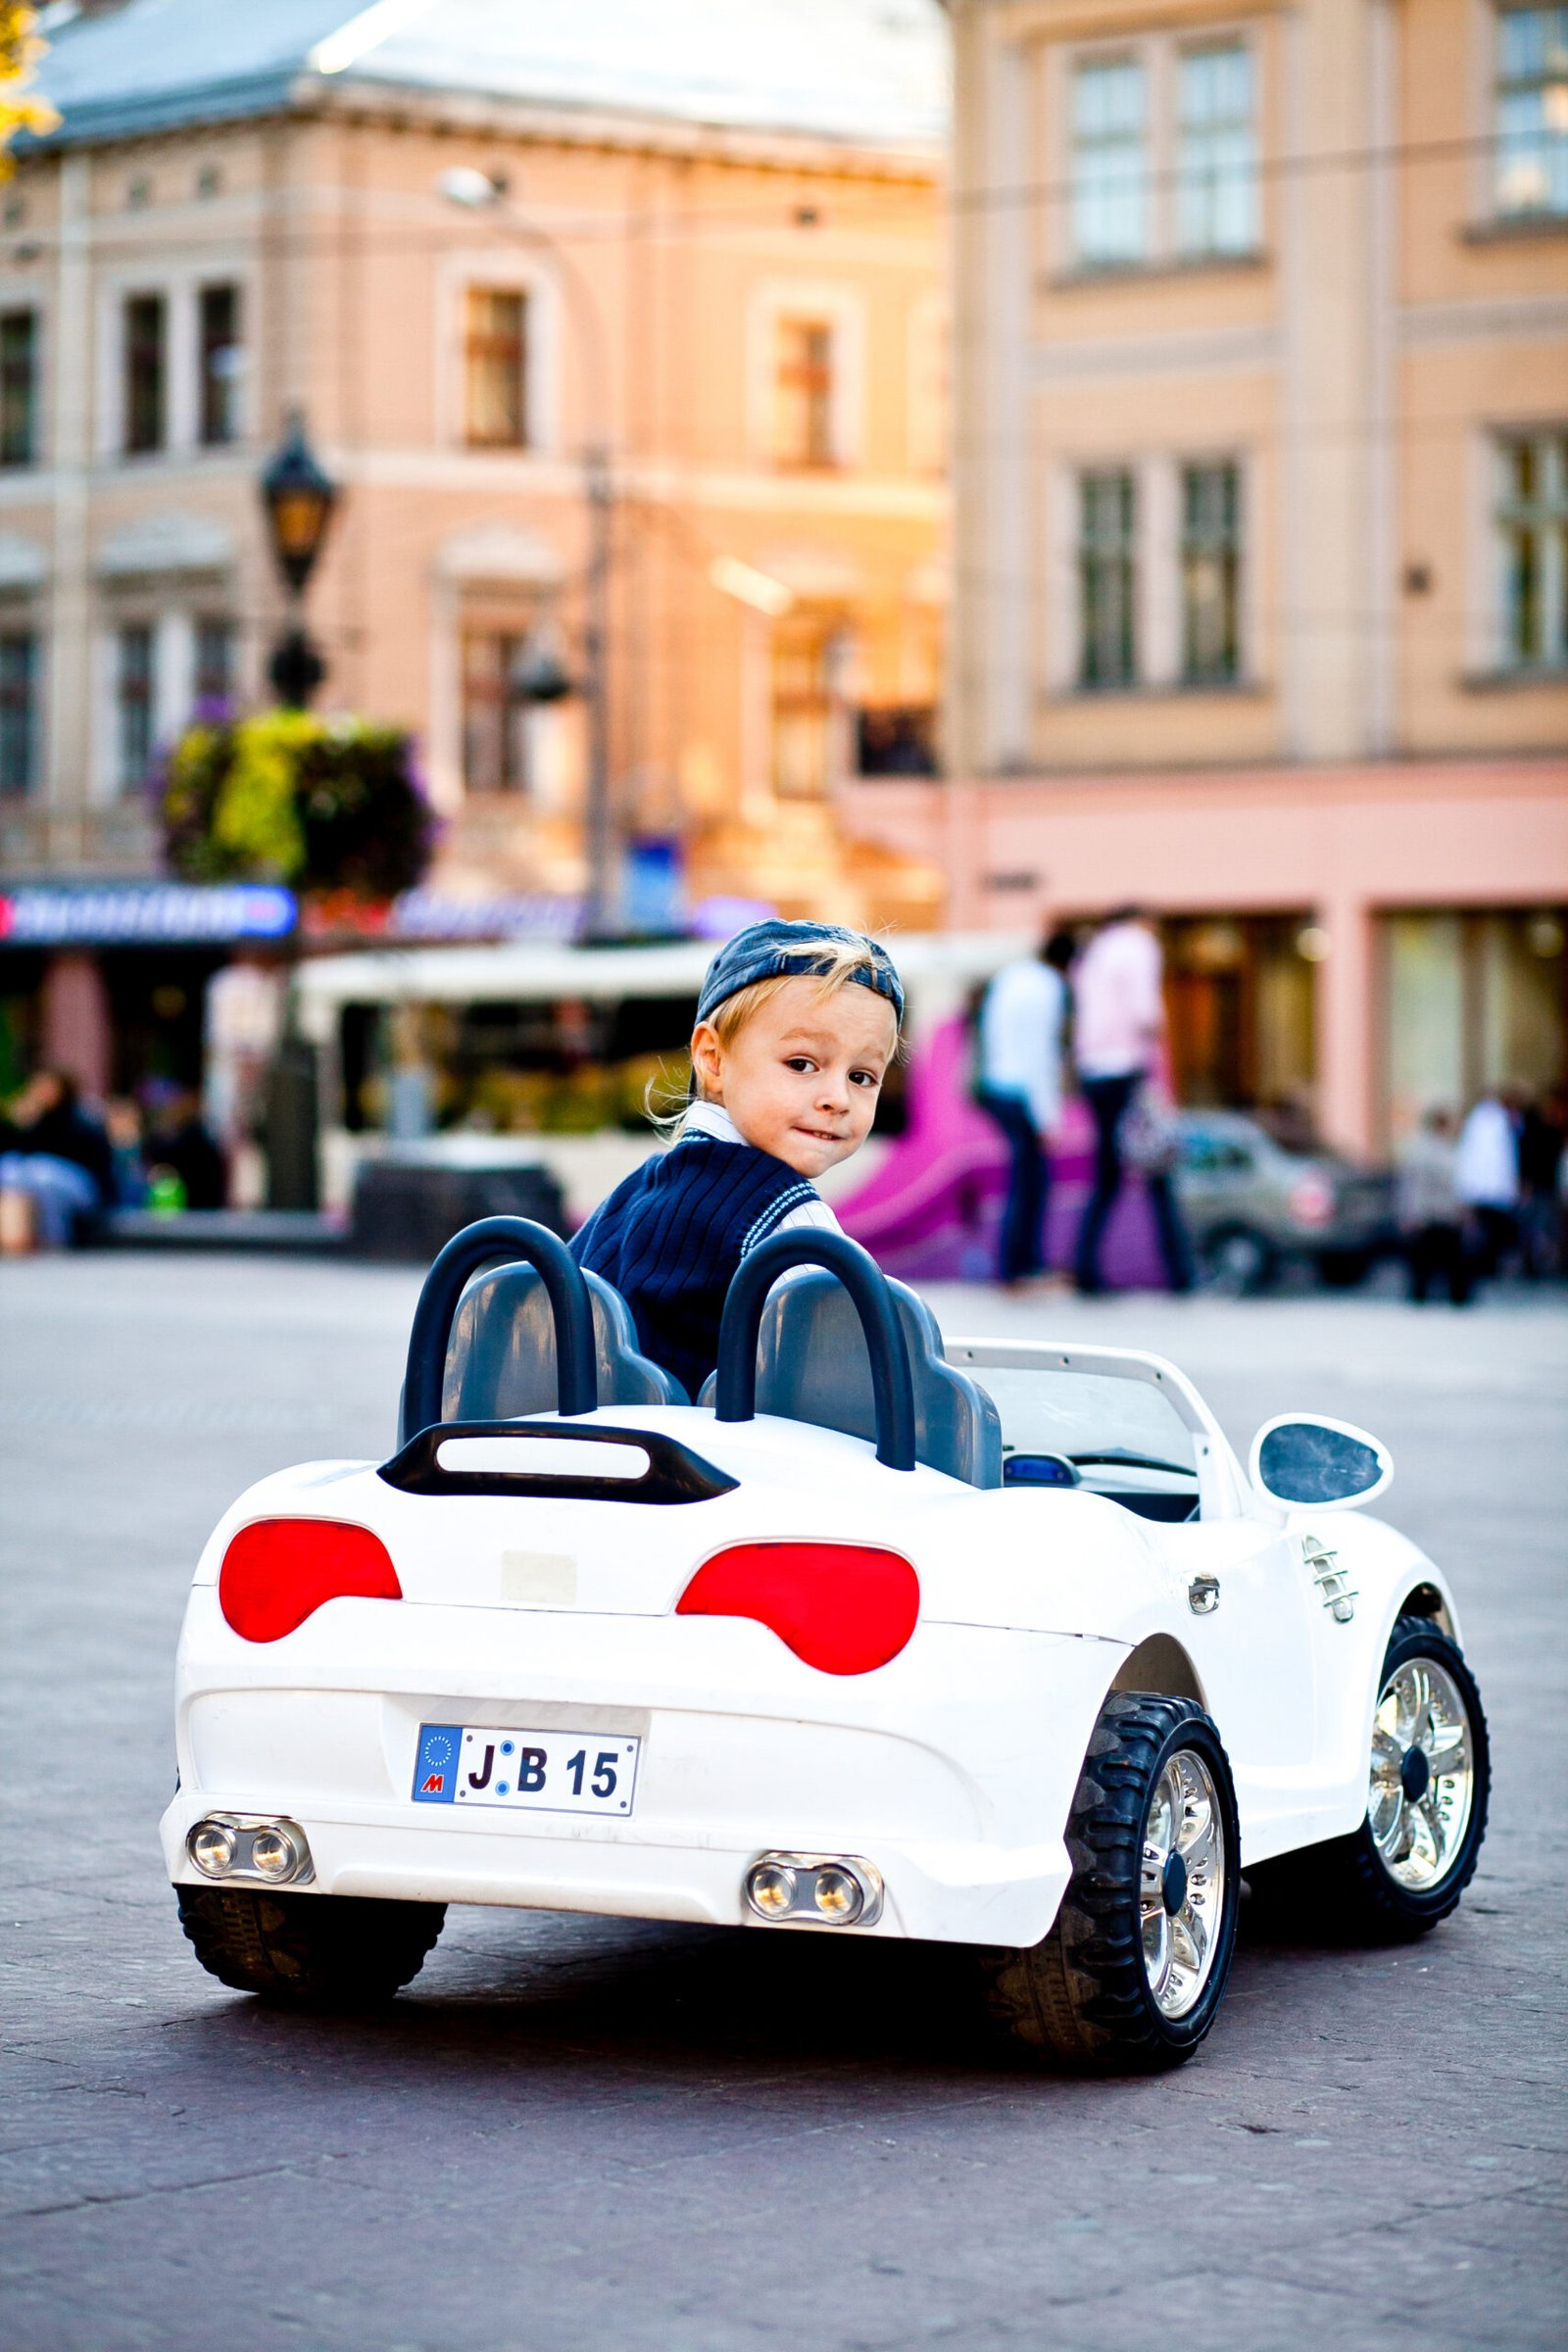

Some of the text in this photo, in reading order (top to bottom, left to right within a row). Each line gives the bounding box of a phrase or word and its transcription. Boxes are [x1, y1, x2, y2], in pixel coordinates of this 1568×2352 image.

[468, 1744, 618, 1797] J B 15
